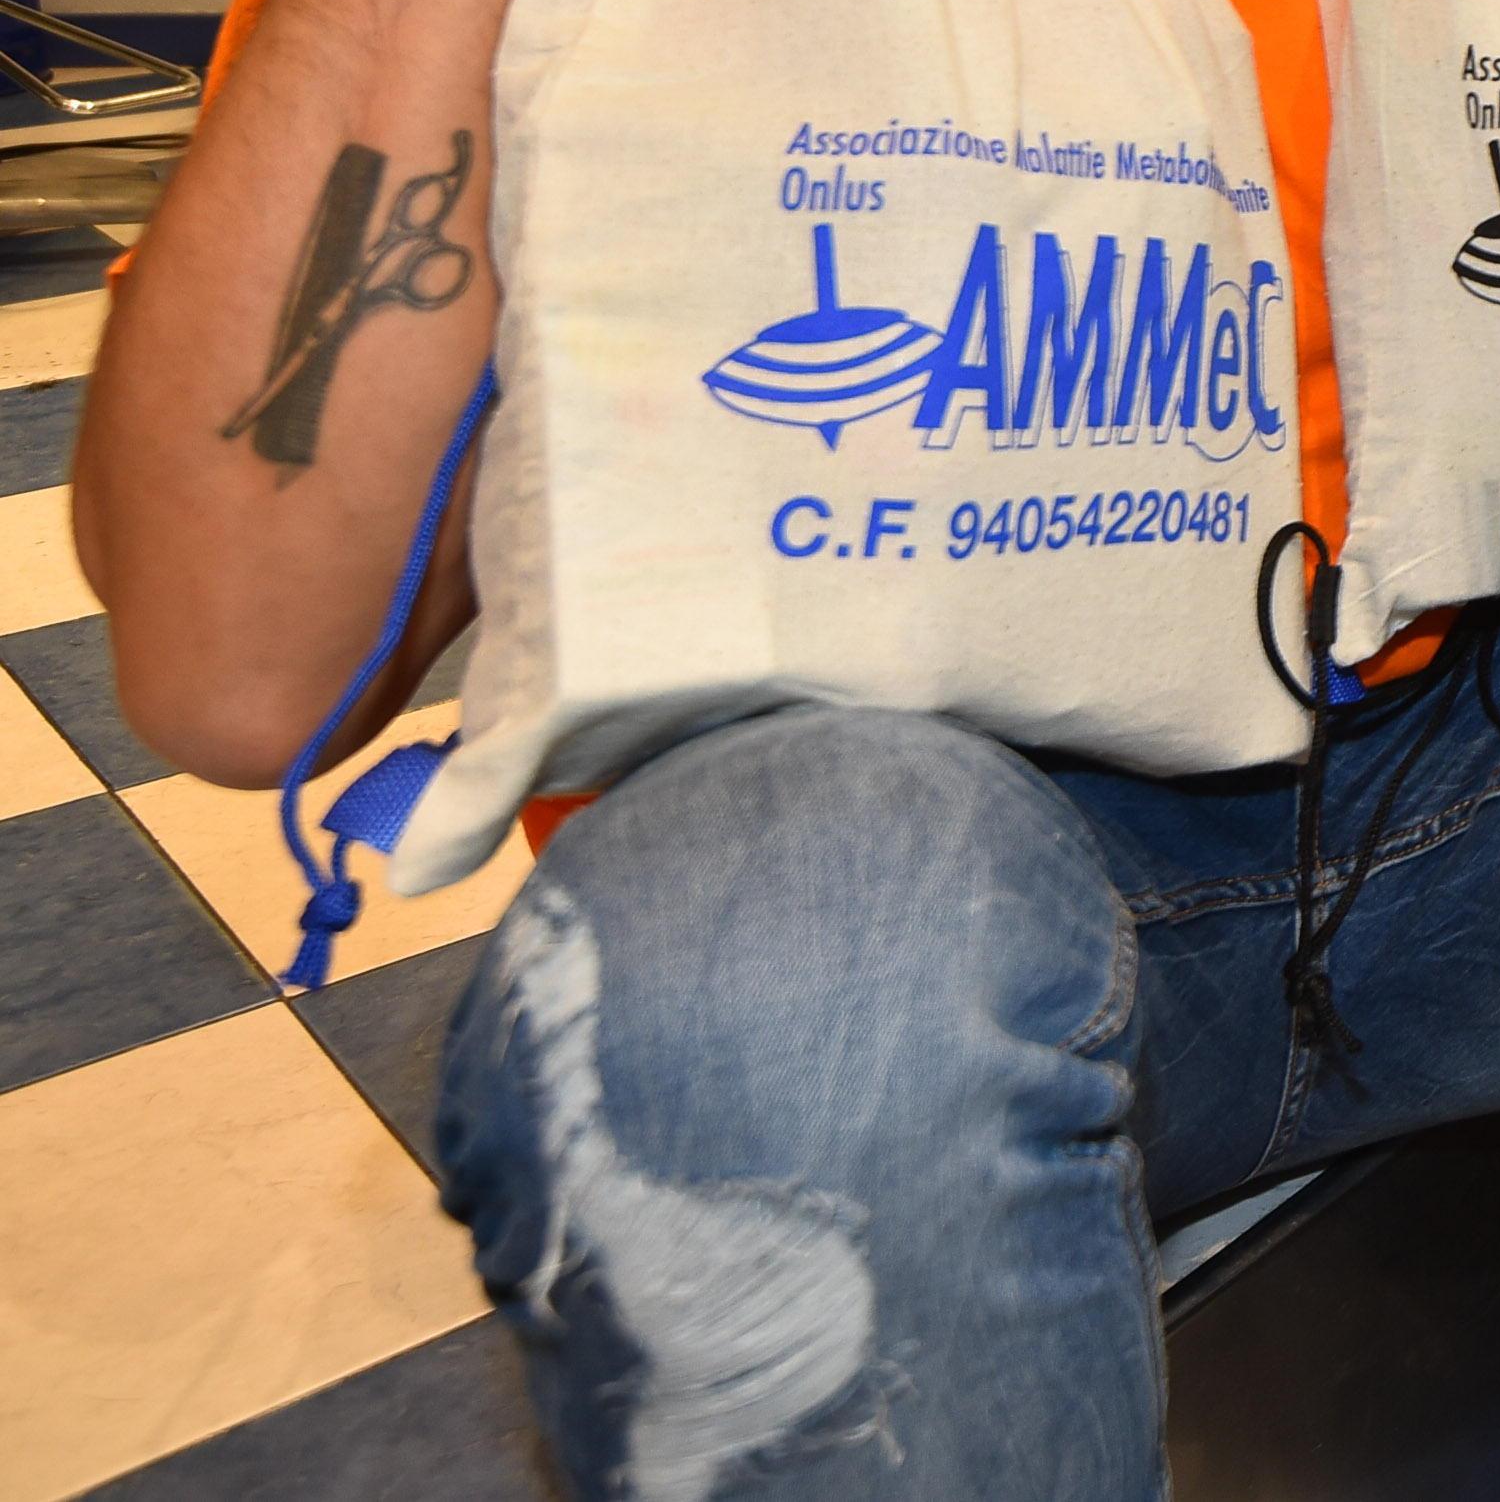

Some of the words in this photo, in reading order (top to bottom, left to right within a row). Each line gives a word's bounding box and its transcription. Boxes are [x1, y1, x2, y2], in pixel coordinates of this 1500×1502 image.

[785, 119, 1008, 164] Associazione
[780, 166, 885, 212] Onlus
[912, 223, 1287, 461] AMMeC
[769, 496, 918, 559] C.F.
[947, 491, 1251, 559] 94054220481
